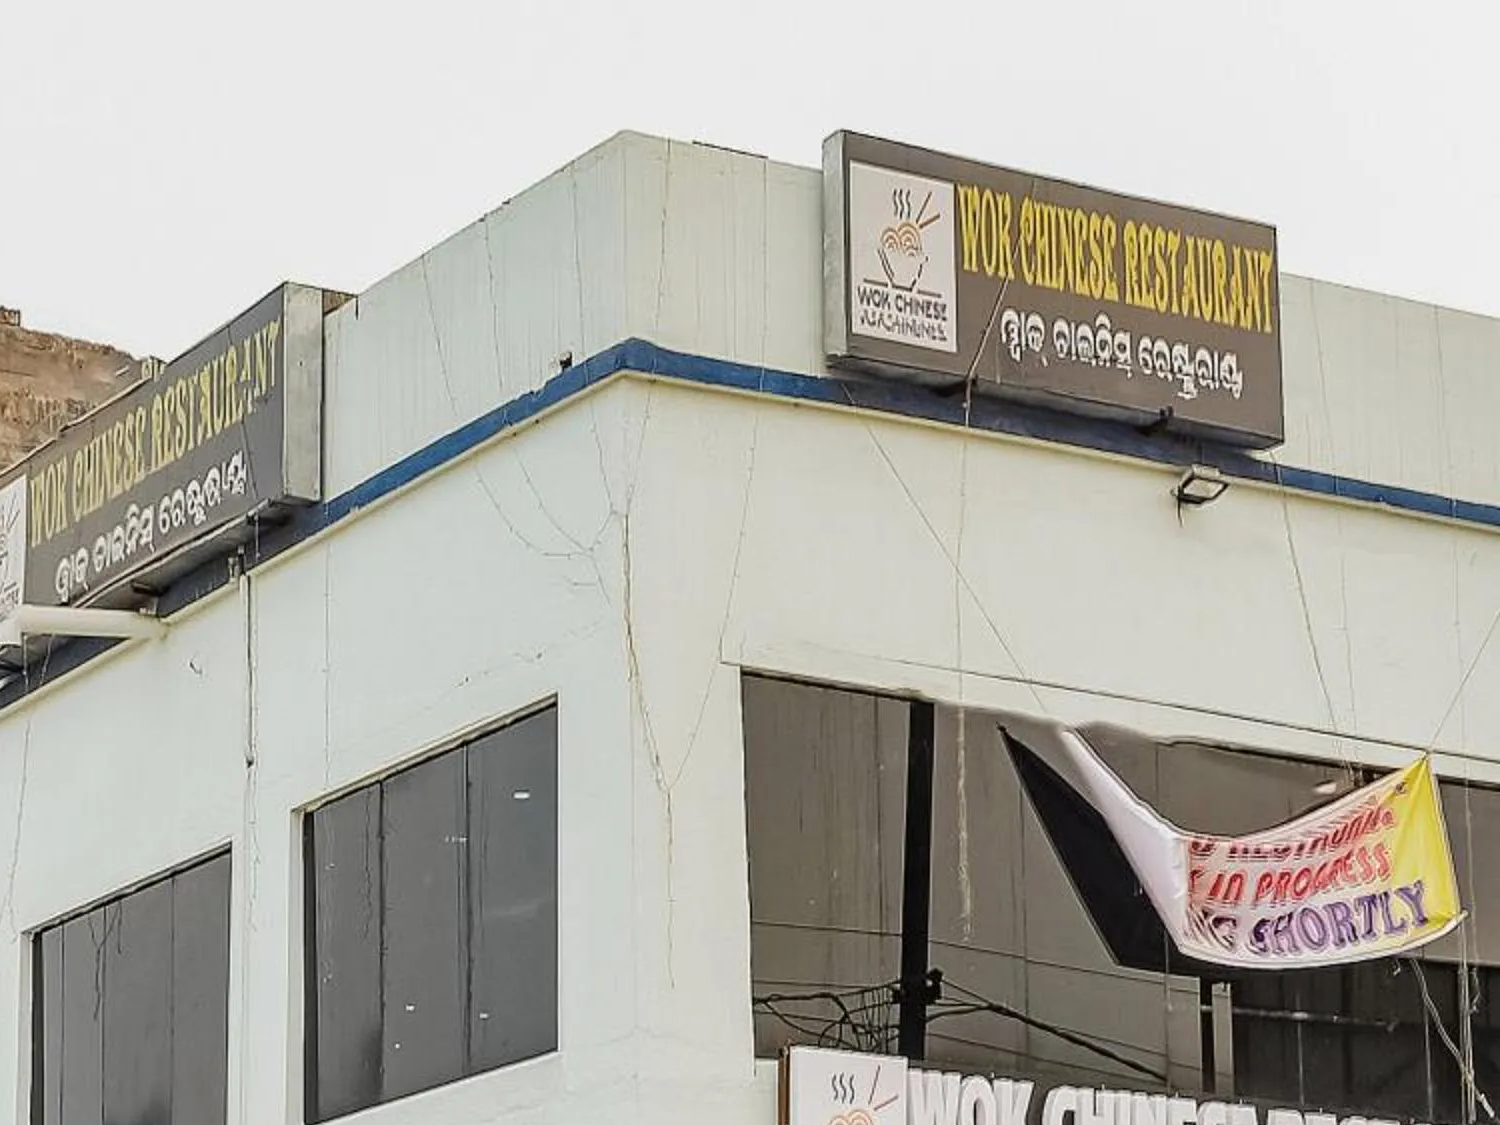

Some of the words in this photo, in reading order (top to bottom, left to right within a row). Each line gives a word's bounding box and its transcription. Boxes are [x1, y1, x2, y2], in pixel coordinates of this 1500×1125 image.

[958, 184, 1015, 280] WOK
[1020, 196, 1119, 302] CHINESE
[1123, 219, 1274, 335] RESTAURANT
[29, 455, 69, 548] WOK
[73, 405, 147, 522] CHINESE
[1246, 880, 1430, 956] SHORTLY
